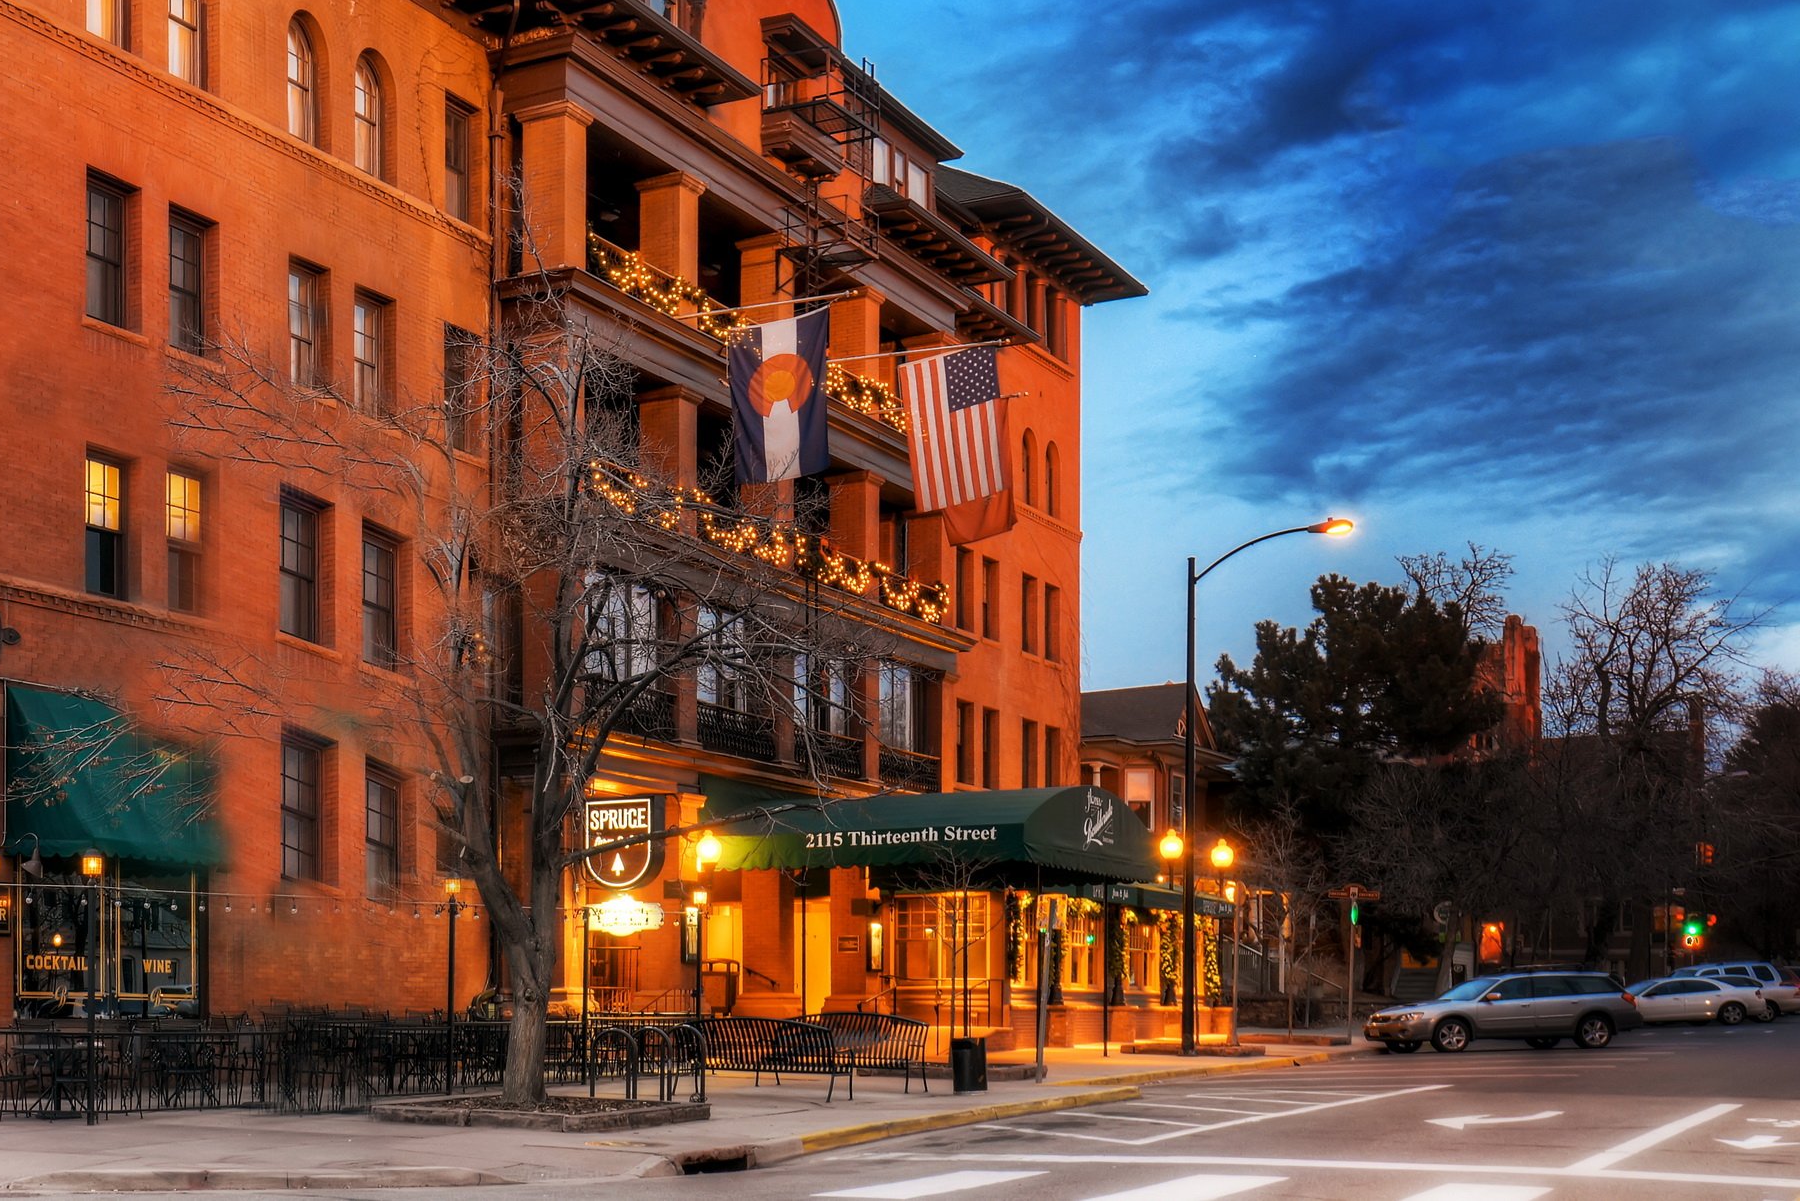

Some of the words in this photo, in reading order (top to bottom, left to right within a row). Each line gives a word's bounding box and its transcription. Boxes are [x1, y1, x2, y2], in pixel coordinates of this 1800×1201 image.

[589, 807, 648, 831] SPRUCE
[805, 832, 843, 848] 2115
[847, 826, 939, 847] Thirteenth
[944, 825, 997, 841] Street
[26, 955, 96, 971] COCKTAIL
[143, 959, 172, 974] WINE
